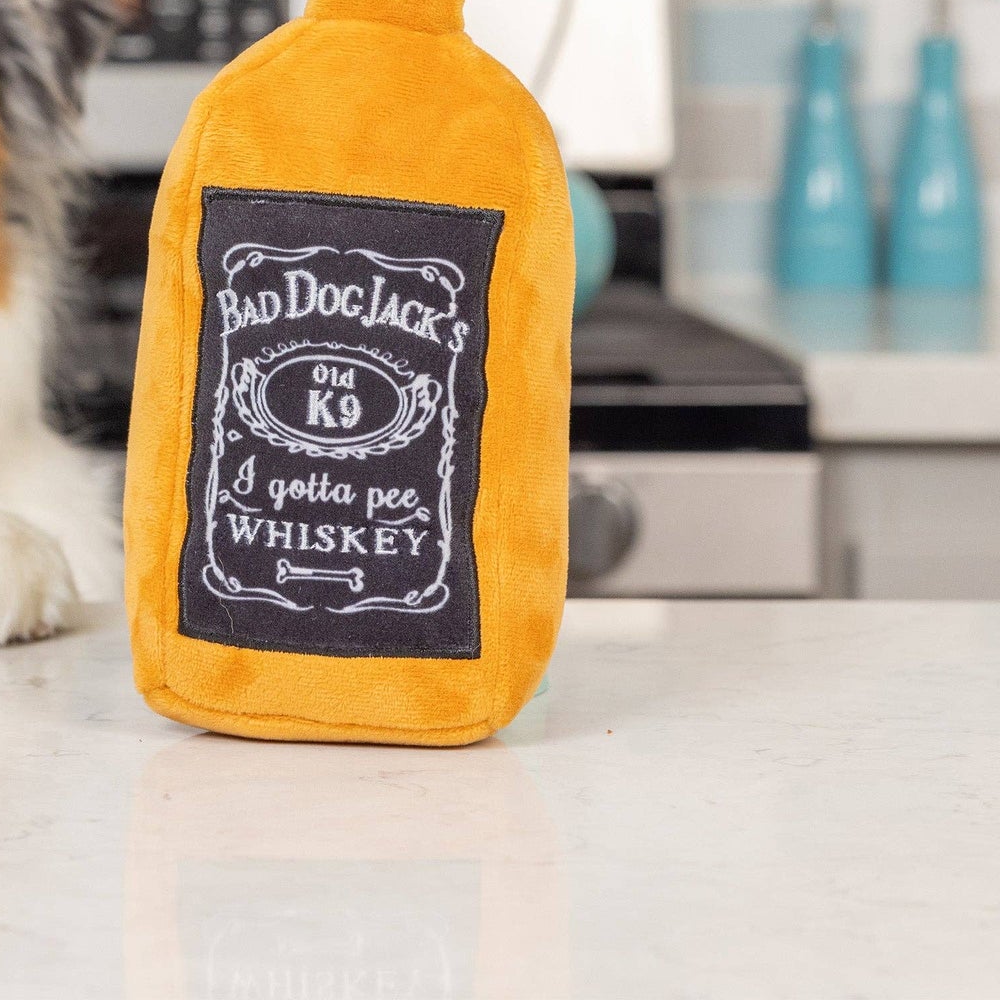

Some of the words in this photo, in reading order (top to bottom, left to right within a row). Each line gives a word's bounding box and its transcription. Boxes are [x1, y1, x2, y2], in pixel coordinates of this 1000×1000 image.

[216, 288, 281, 336] BAD
[284, 269, 364, 319] DOG
[306, 389, 362, 429] K9
[268, 472, 357, 511] gotta
[366, 486, 419, 519] pee
[226, 513, 428, 556] WHISKEY
